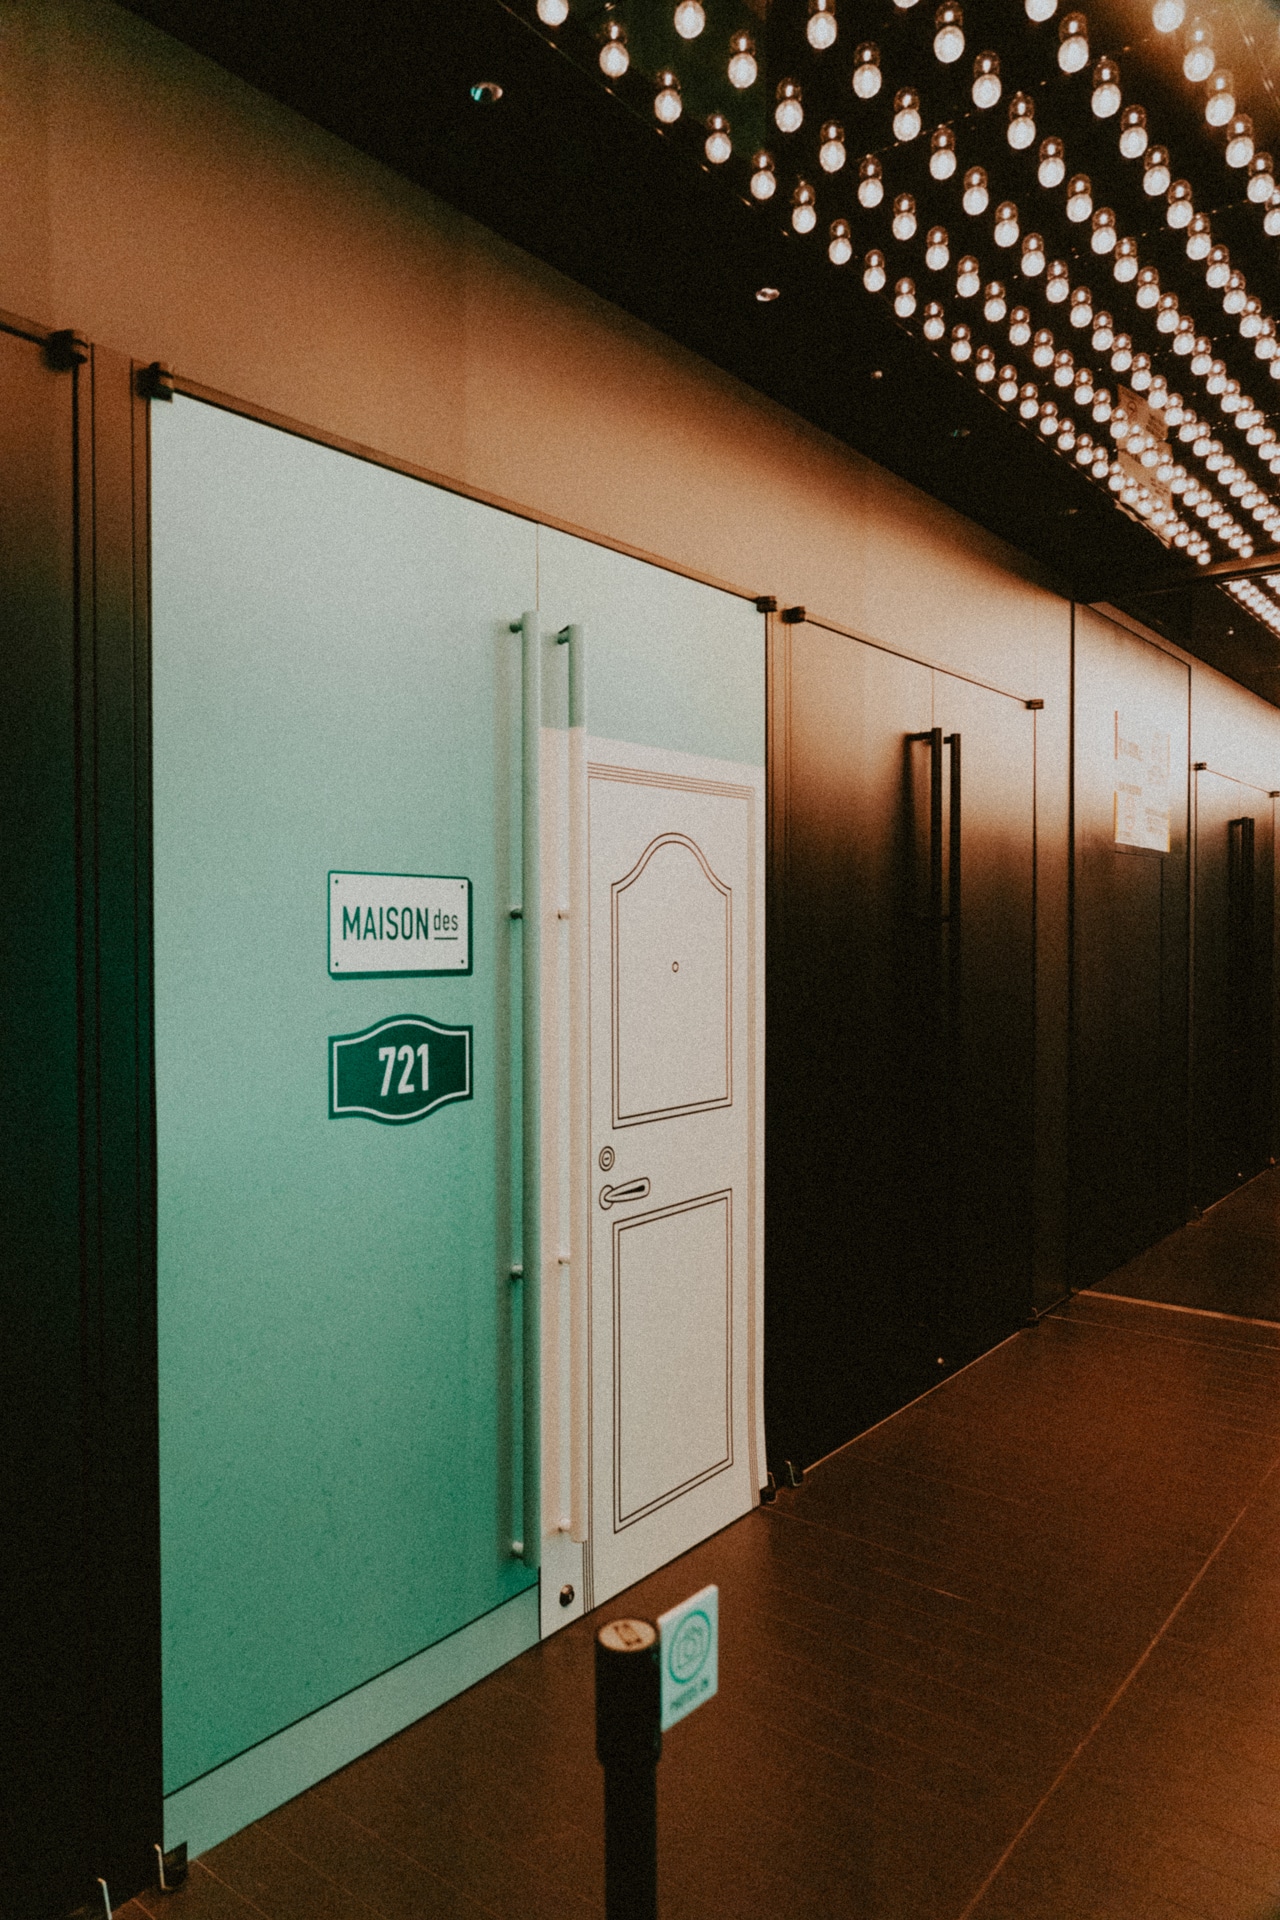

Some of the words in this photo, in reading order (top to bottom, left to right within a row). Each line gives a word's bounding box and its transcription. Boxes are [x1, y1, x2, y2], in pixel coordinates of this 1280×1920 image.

[342, 905, 429, 941] MAISON
[433, 908, 459, 932] des
[378, 1043, 429, 1097] 721
